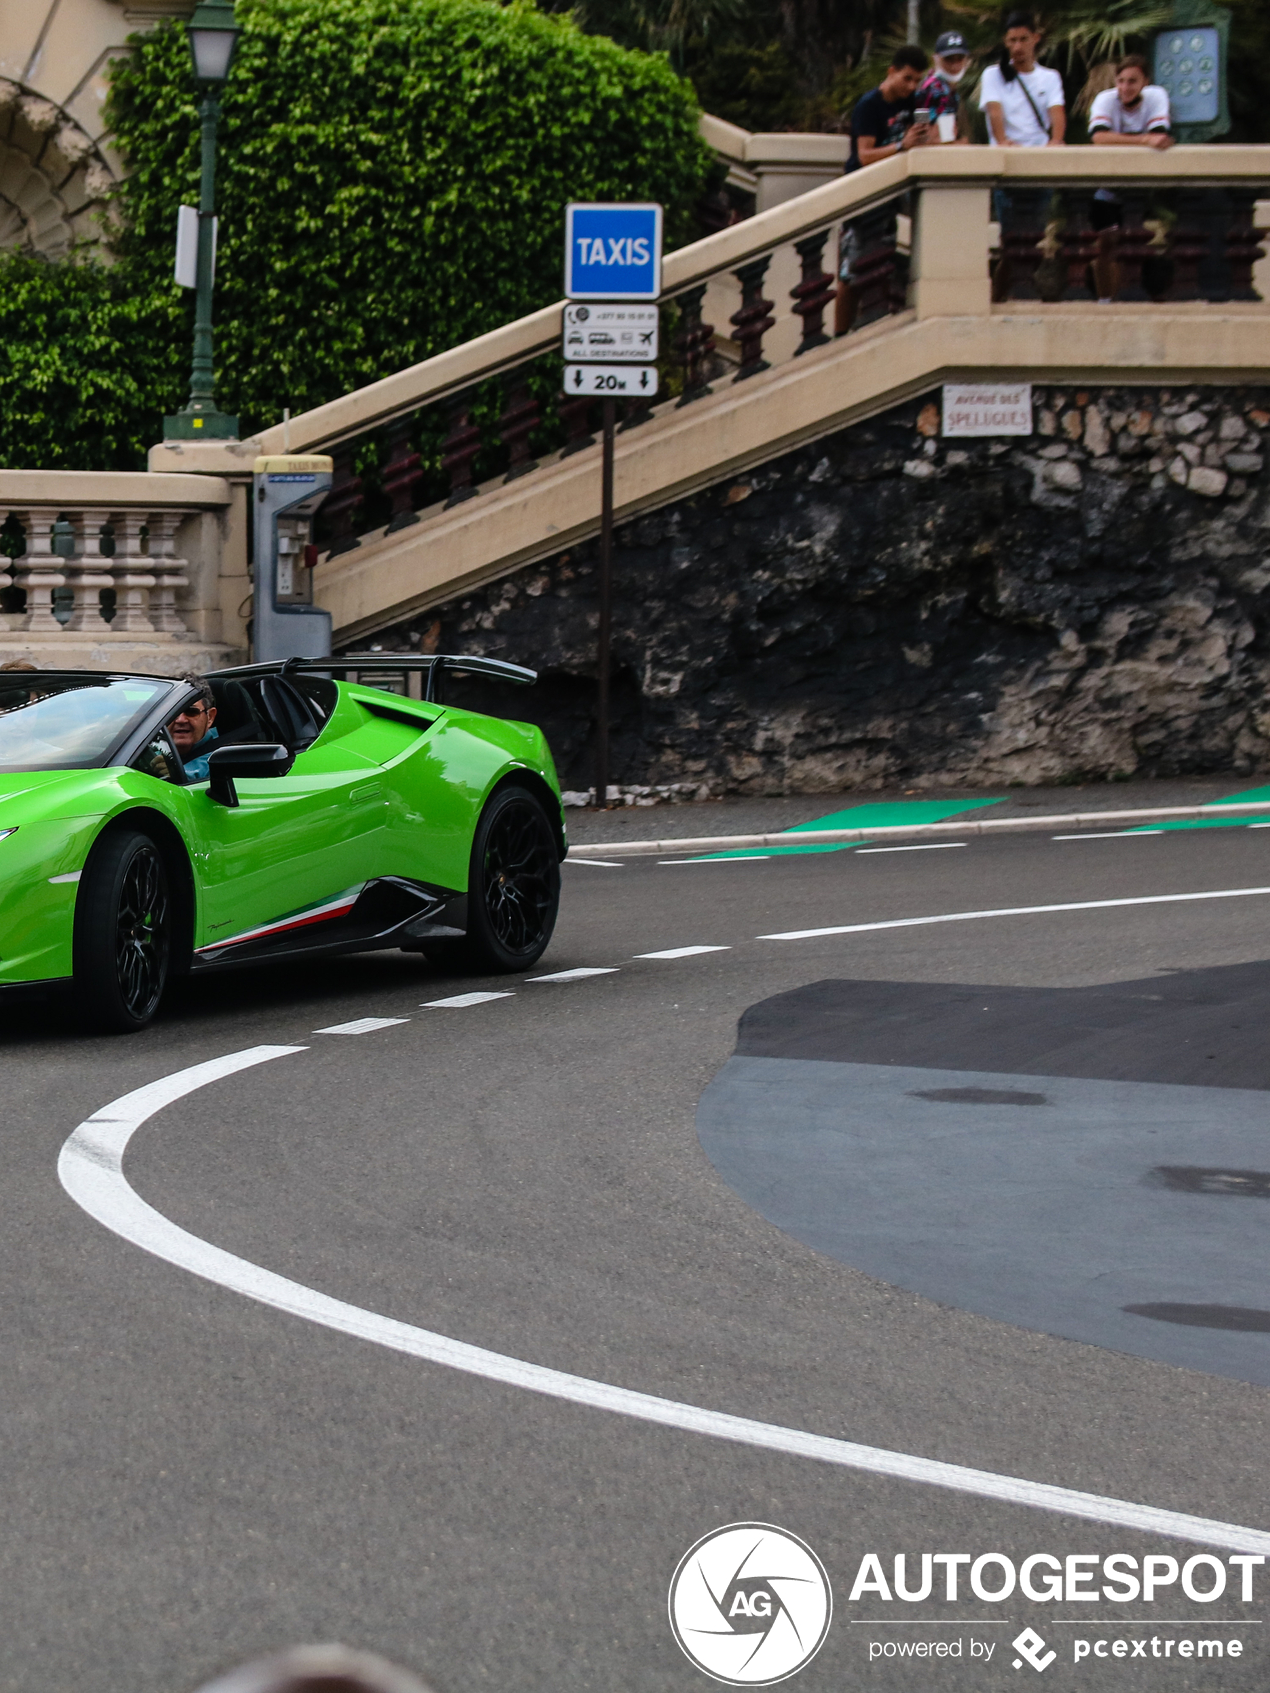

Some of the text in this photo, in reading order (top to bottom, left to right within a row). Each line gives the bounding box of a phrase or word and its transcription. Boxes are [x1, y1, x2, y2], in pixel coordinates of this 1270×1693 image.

[576, 237, 650, 266] TAXIS
[572, 349, 649, 357] ALL DESTINATIONS
